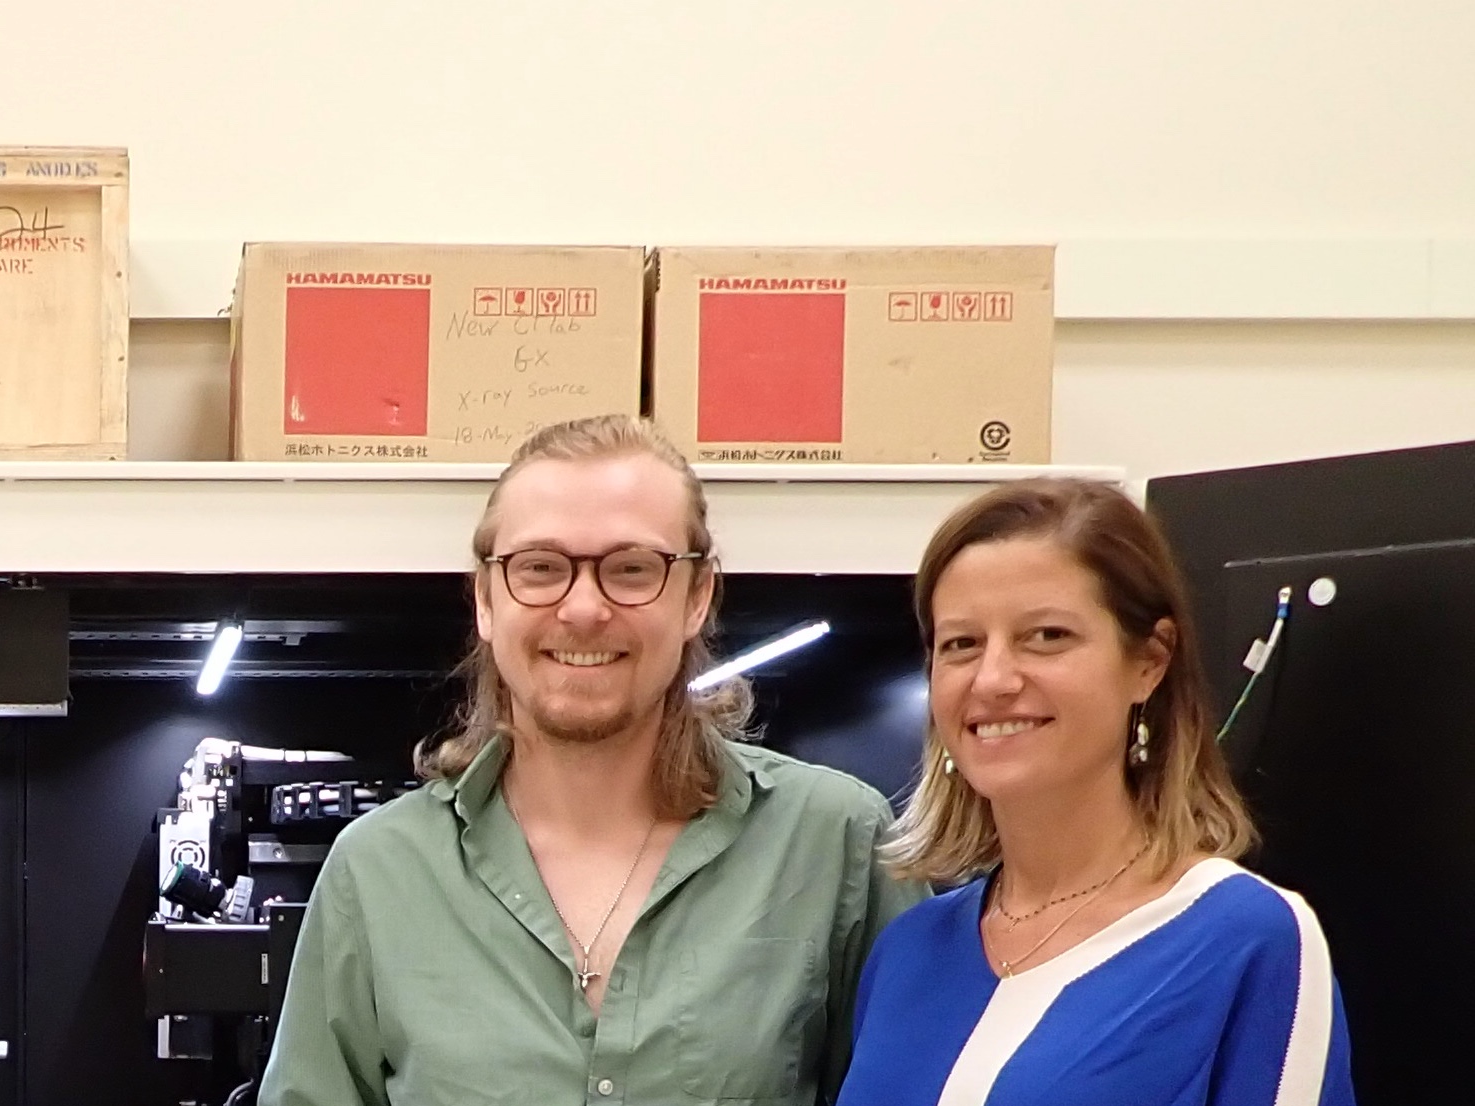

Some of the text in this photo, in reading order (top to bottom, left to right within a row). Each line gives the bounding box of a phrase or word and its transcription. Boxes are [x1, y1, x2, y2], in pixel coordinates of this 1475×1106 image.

[26, 161, 99, 177] ANODES
[286, 272, 432, 286] HAMAMATSU
[699, 278, 847, 290] HAMAMATSU
[446, 310, 499, 340] New
[285, 443, 429, 458] 浜松ホトニクス株式会社
